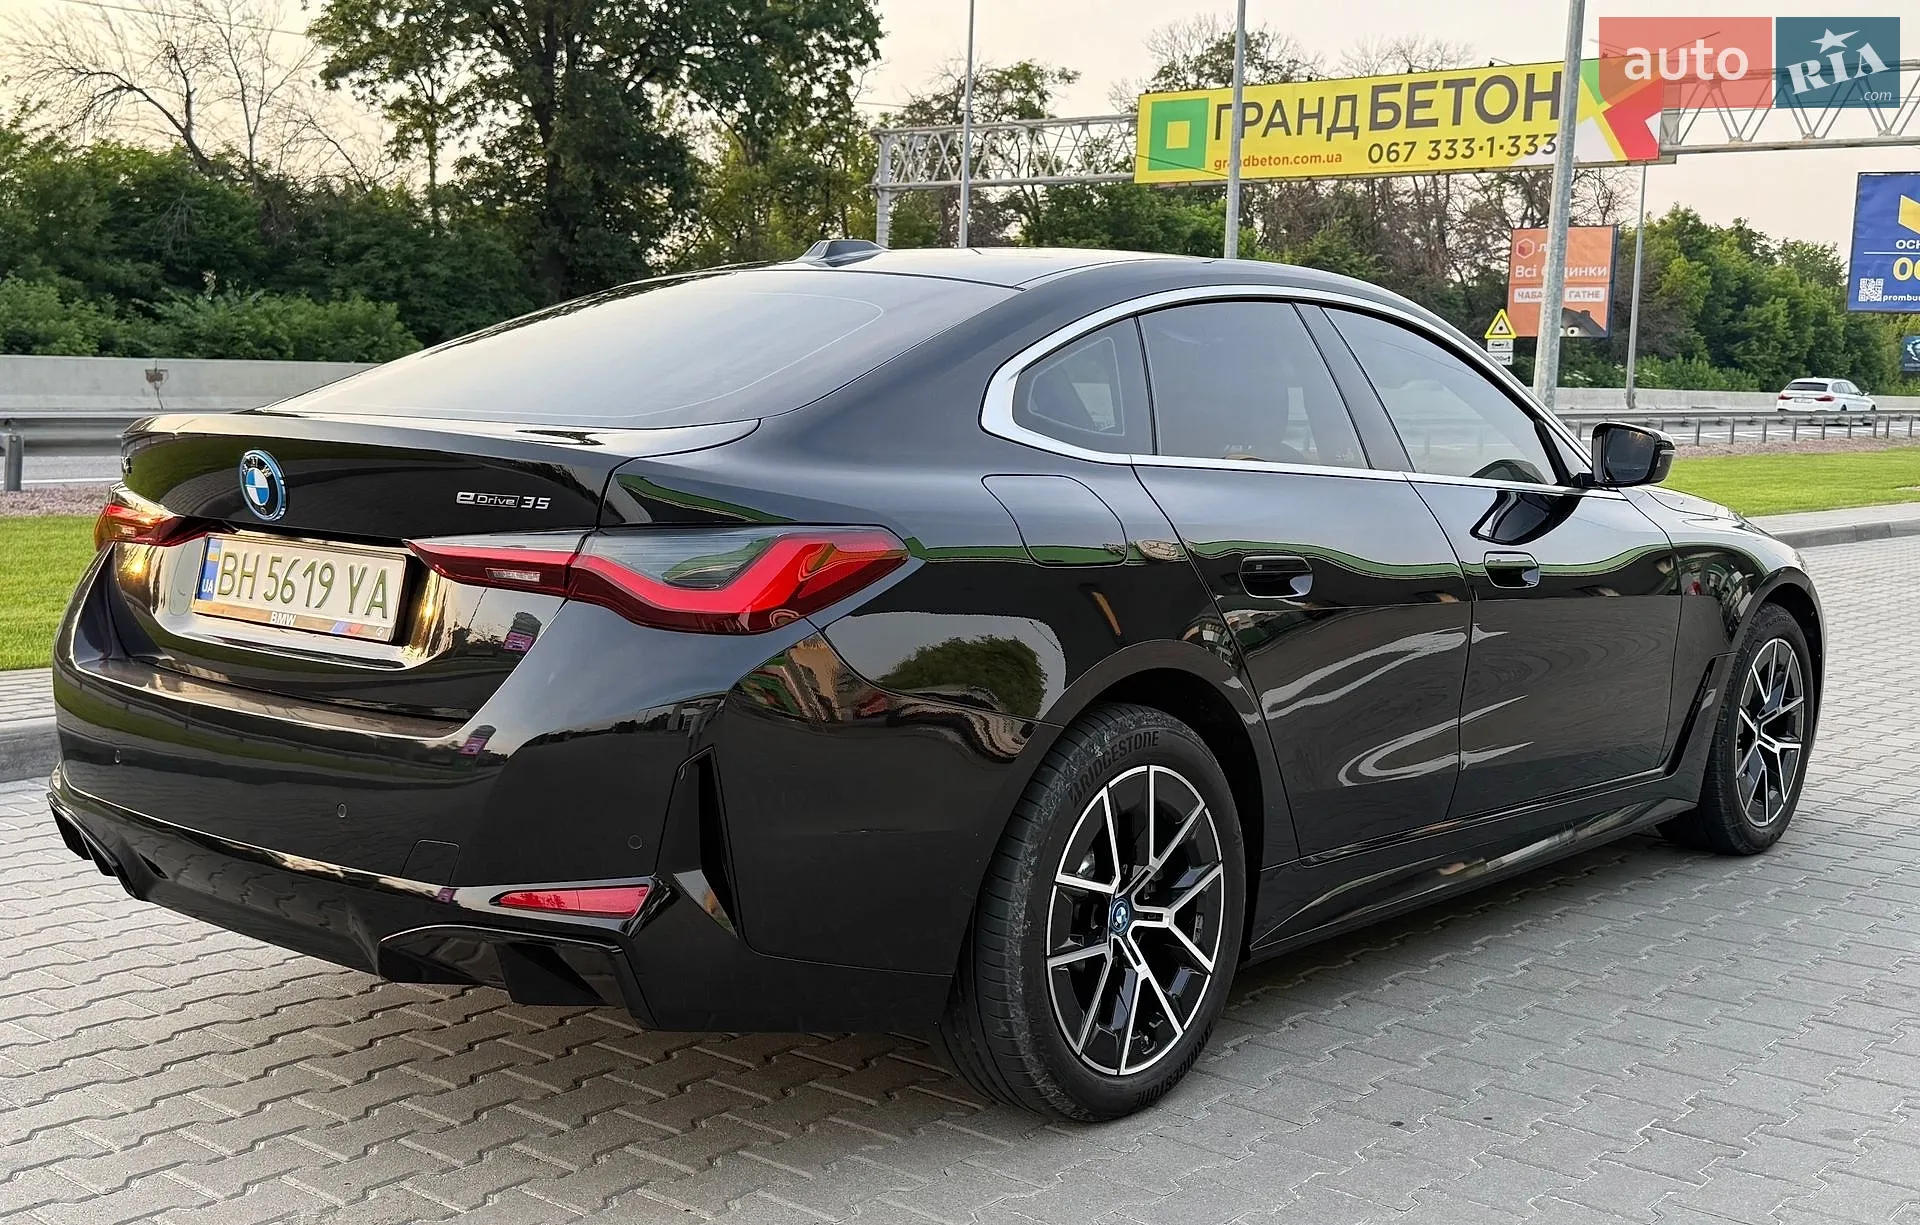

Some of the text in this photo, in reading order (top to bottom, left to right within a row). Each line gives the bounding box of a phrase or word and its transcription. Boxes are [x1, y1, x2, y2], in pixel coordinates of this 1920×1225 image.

[1214, 70, 1563, 142] ГРАНД БЕТОН
[1368, 141, 1417, 164] 067
[1214, 152, 1343, 171] grdbeton.com.ua
[1515, 264, 1537, 278] Всі
[1517, 290, 1601, 299] ЧАБА ГАТНЕ
[1883, 294, 1920, 303] prombu
[520, 496, 551, 510] 35
[201, 578, 214, 594] UA
[217, 551, 388, 619] BH 5619 YA
[271, 611, 297, 626] BMW
[1067, 730, 1160, 809] BRIDGESTONE
